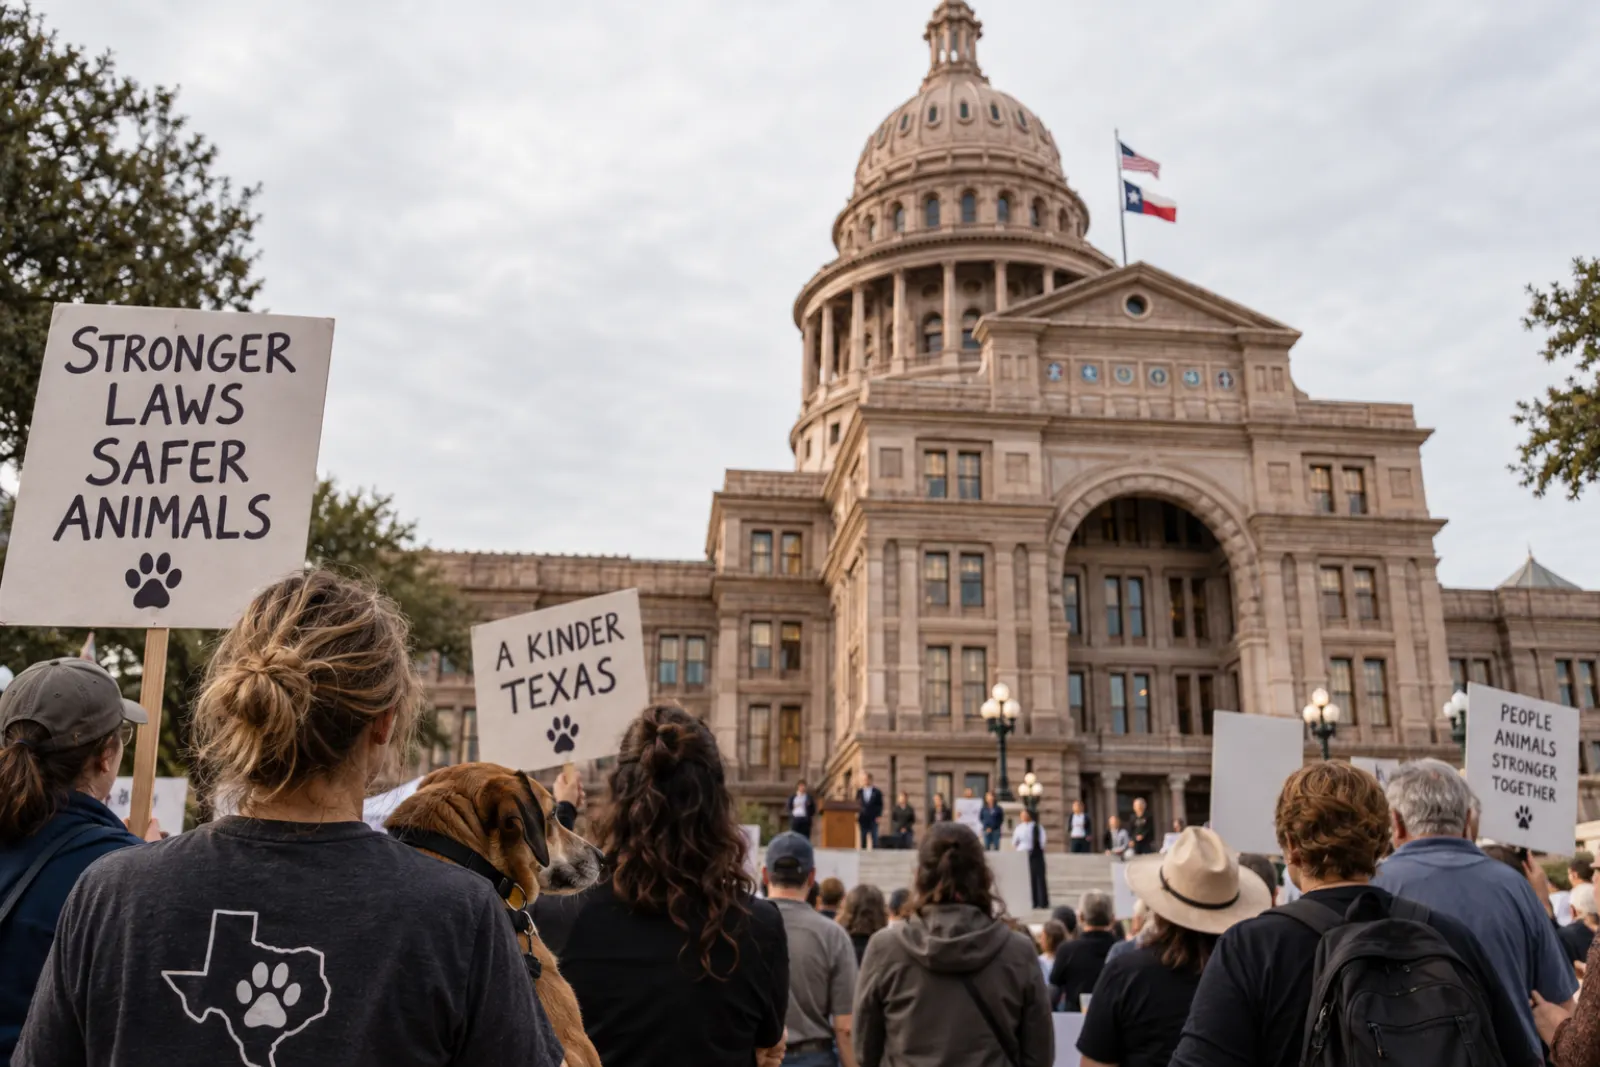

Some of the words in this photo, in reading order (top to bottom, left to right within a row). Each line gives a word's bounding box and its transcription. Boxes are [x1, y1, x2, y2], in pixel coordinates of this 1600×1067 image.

[64, 325, 297, 374] STRONGER
[105, 382, 244, 426] LAWS
[85, 437, 249, 486] SAFER
[53, 494, 271, 541] ANIMALS
[496, 641, 515, 672] A
[527, 612, 625, 663] KINDER
[500, 656, 617, 714] TEXAS
[1501, 703, 1552, 732] PEOPLE
[1494, 729, 1557, 758] ANIMALS
[1492, 752, 1558, 781] STRONGER
[1492, 775, 1556, 803] TOGETHER
